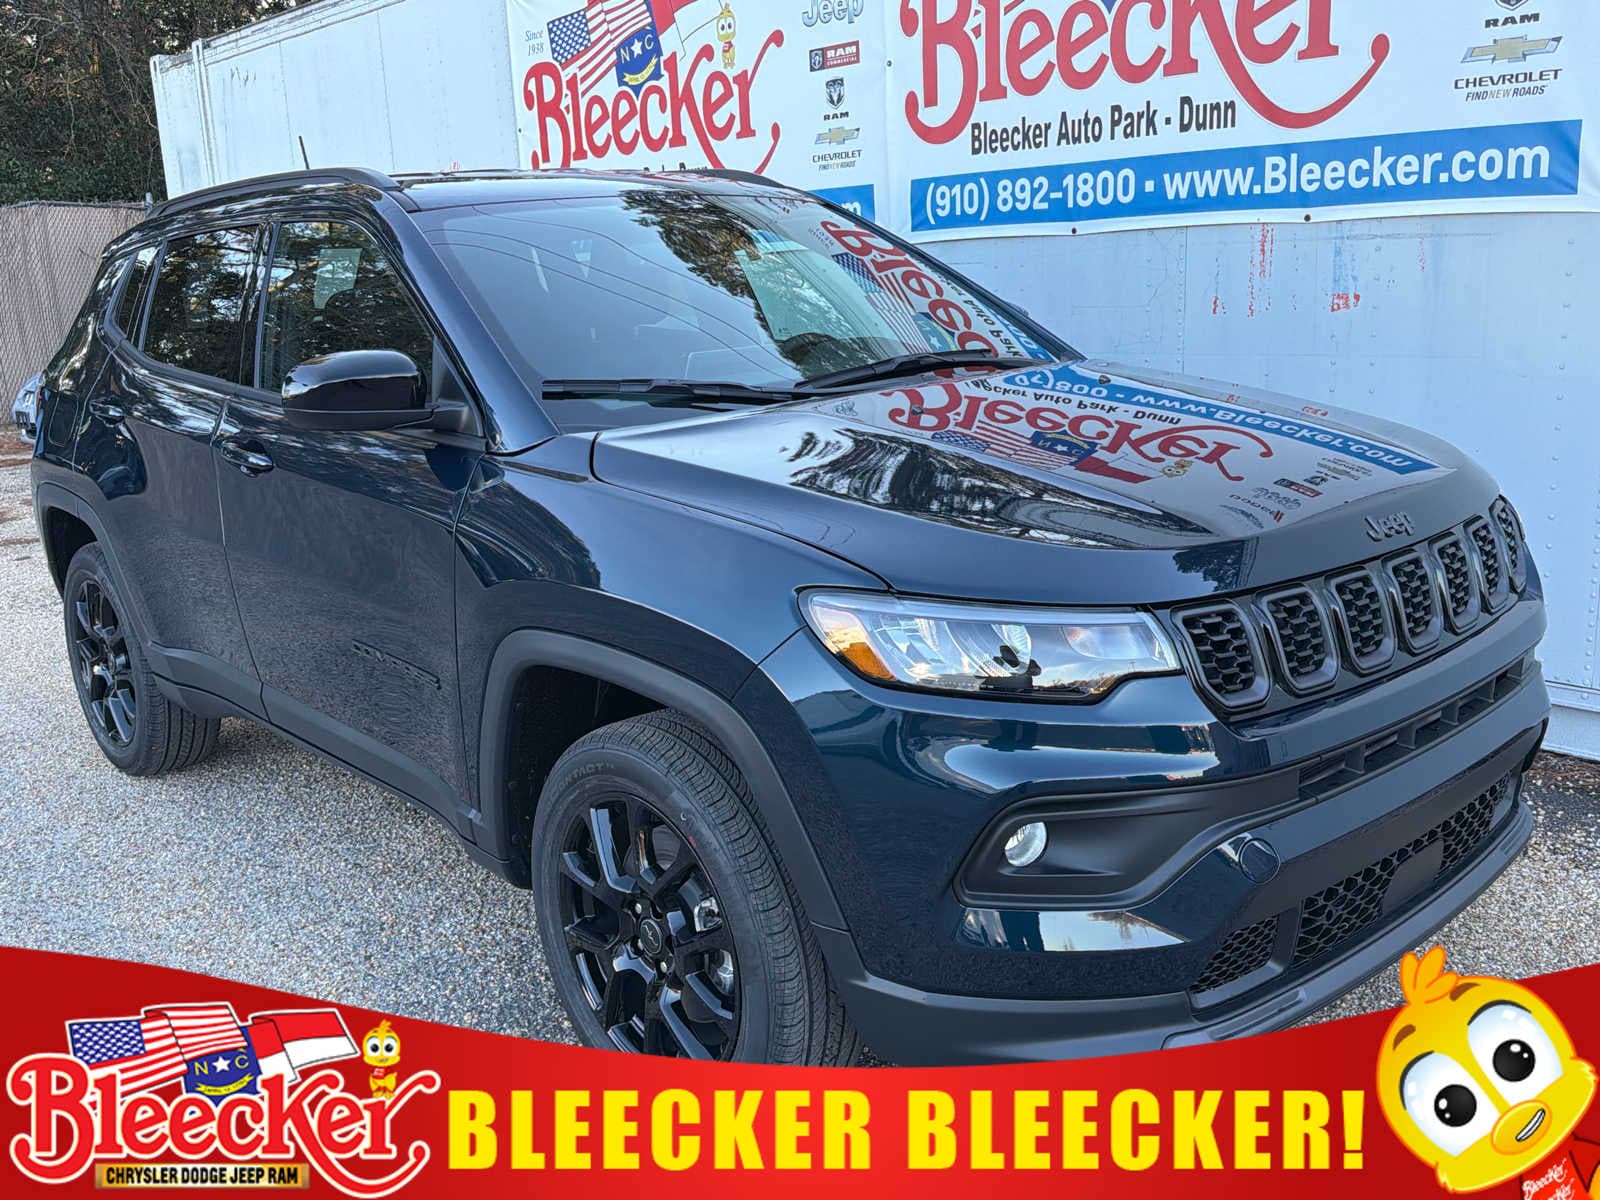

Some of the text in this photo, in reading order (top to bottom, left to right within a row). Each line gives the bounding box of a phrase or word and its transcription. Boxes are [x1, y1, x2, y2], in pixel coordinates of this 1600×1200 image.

[802, 0, 864, 27] Jeep
[1485, 13, 1540, 28] RAM
[826, 45, 857, 58] RAM
[1454, 69, 1563, 90] CHEVROLET
[523, 29, 784, 174] Bleecker
[1465, 85, 1548, 102] FIND NEW ROADS
[823, 111, 849, 121] RAM
[970, 96, 1236, 156] Bleecker Auto Park Dunn
[812, 149, 862, 163] CHEVROLET
[926, 142, 1550, 223] (910) 892-1800 www.Bleecker.com
[1365, 512, 1416, 542] Jeep
